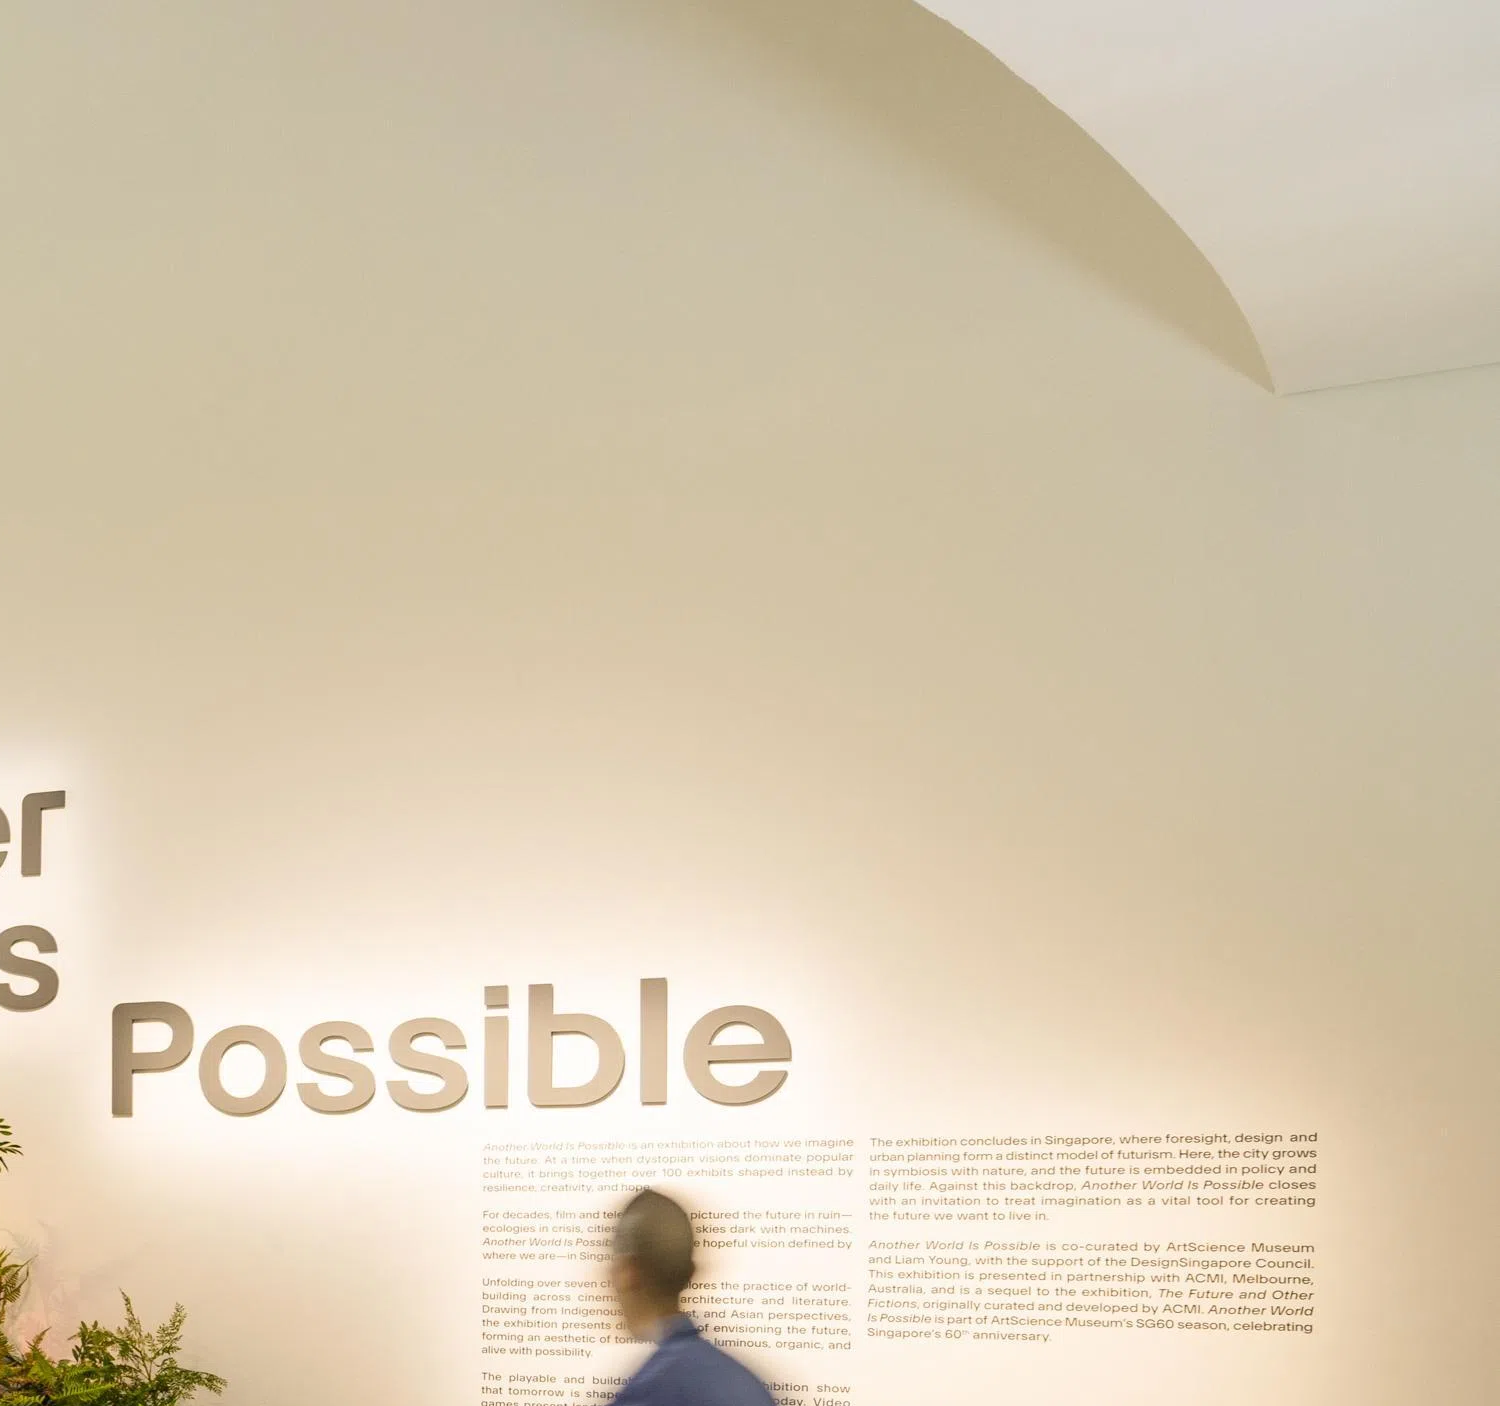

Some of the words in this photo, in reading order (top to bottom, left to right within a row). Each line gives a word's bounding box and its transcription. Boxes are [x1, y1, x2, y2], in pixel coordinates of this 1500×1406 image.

[111, 976, 793, 1119] Possible
[870, 1137, 894, 1147] The
[895, 1136, 958, 1147] exhibition
[959, 1136, 1028, 1147] concludes
[1030, 1135, 1042, 1145] in
[1044, 1135, 1116, 1148] Singapore,
[1119, 1134, 1163, 1145] where
[1165, 1133, 1232, 1146] foresight,
[1234, 1132, 1284, 1145] design
[1289, 1132, 1318, 1143] and
[869, 1152, 905, 1162] urban
[907, 1151, 961, 1164] planning
[962, 1151, 994, 1161] form
[995, 1152, 1003, 1161] a
[1005, 1151, 1054, 1161] distinct
[1056, 1150, 1099, 1161] model
[1100, 1148, 1115, 1160] of
[1116, 1149, 1177, 1160] futurism.
[1178, 1148, 1215, 1160] Here,
[1217, 1148, 1241, 1159] the
[1242, 1148, 1270, 1161] city
[1271, 1148, 1318, 1161] grows
[869, 1166, 881, 1177] in
[883, 1167, 948, 1178] symbiosis
[951, 1166, 979, 1176] with
[982, 1167, 1027, 1177] nature,
[1030, 1165, 1056, 1176] and
[1059, 1165, 1082, 1176] the
[1084, 1165, 1126, 1176] future
[1129, 1164, 1141, 1175] is
[1143, 1164, 1222, 1175] embedded
[1224, 1165, 1238, 1175] in
[1241, 1163, 1286, 1177] policy
[1288, 1163, 1317, 1175] and
[869, 1182, 899, 1193] daily
[903, 1181, 925, 1191] life.
[929, 1181, 978, 1193] Against
[982, 1181, 1007, 1191] this
[1010, 1180, 1077, 1193] backdrop,
[1080, 1180, 1138, 1191] Another
[1141, 1179, 1185, 1191] World
[1187, 1180, 1200, 1191] Is
[1202, 1179, 1265, 1191] Possible
[1268, 1179, 1317, 1192] closes
[869, 1196, 897, 1206] with
[900, 1198, 917, 1206] an
[921, 1195, 981, 1207] invitation
[985, 1196, 1000, 1206] to
[1004, 1196, 1036, 1206] treat
[1040, 1195, 1122, 1208] imagination
[1126, 1197, 1143, 1206] as
[1147, 1196, 1156, 1206] a
[1160, 1195, 1191, 1206] vital
[1196, 1195, 1224, 1206] tool
[1228, 1195, 1250, 1206] for
[1254, 1195, 1316, 1209] creating
[868, 1210, 890, 1221] the
[892, 1210, 931, 1221] future
[933, 1212, 954, 1221] we
[956, 1211, 989, 1221] want
[992, 1211, 1006, 1221] to
[1008, 1210, 1032, 1221] live
[1034, 1210, 1052, 1221] in.
[695, 1223, 727, 1234] skies
[727, 1223, 756, 1234] dark
[759, 1224, 787, 1235] with
[789, 1224, 853, 1235] machines.
[868, 1239, 921, 1250] Another
[925, 1240, 964, 1250] World
[968, 1241, 980, 1251] Is
[983, 1240, 1041, 1251] Possible
[1045, 1242, 1057, 1251] is
[1061, 1241, 1139, 1252] co-curated
[1143, 1241, 1161, 1254] by
[1165, 1241, 1246, 1253] ArtScience
[1251, 1242, 1315, 1254] Museum
[868, 1255, 892, 1265] and
[895, 1255, 925, 1265] Liam
[928, 1255, 971, 1268] Young,
[974, 1255, 1003, 1265] with
[1006, 1255, 1028, 1266] the
[1031, 1257, 1084, 1268] support
[1087, 1255, 1102, 1267] of
[1104, 1257, 1128, 1267] the
[1130, 1256, 1252, 1270] DesignSingapore
[1254, 1258, 1315, 1269] Council.
[868, 1269, 894, 1279] This
[897, 1270, 961, 1280] exhibition
[964, 1271, 975, 1281] is
[978, 1271, 1047, 1282] presented
[1050, 1272, 1062, 1281] in
[1066, 1272, 1146, 1285] partnership
[1150, 1272, 1181, 1283] with
[1184, 1272, 1228, 1285] ACMI,
[1232, 1273, 1314, 1286] Melbourne,
[679, 1292, 755, 1306] architecture
[760, 1295, 785, 1306] and
[791, 1296, 852, 1307] literature.
[867, 1283, 926, 1295] Australia,
[930, 1285, 955, 1295] and
[959, 1286, 970, 1295] is
[974, 1287, 983, 1295] a
[987, 1286, 1032, 1297] sequel
[1036, 1287, 1050, 1297] to
[1054, 1287, 1077, 1297] the
[1081, 1287, 1152, 1299] exhibition,
[1158, 1288, 1184, 1299] The
[1187, 1288, 1235, 1300] Future
[1238, 1289, 1268, 1300] and
[1271, 1289, 1315, 1301] Other
[867, 1298, 920, 1310] Fictions,
[922, 1299, 981, 1312] originally
[983, 1301, 1035, 1311] curated
[1037, 1302, 1063, 1312] and
[1065, 1302, 1139, 1315] developed
[1141, 1303, 1159, 1316] by
[1161, 1303, 1205, 1315] ACMI.
[1207, 1304, 1268, 1316] Another
[1270, 1305, 1315, 1317] World
[867, 1312, 878, 1323] Is
[879, 1313, 932, 1324] Possible
[934, 1315, 945, 1324] is
[946, 1315, 973, 1326] part
[974, 1314, 988, 1325] of
[990, 1315, 1063, 1327] ArtScience
[1135, 1318, 1175, 1330] SG60
[1177, 1321, 1230, 1332] season,
[1232, 1320, 1314, 1335] celebrating
[712, 1337, 772, 1350] luminous,
[775, 1340, 825, 1351] organic,
[828, 1340, 852, 1351] and
[972, 1330, 1053, 1343] anniversary.
[481, 1345, 507, 1355] alive
[508, 1346, 533, 1356] with
[534, 1347, 596, 1359] possibility.
